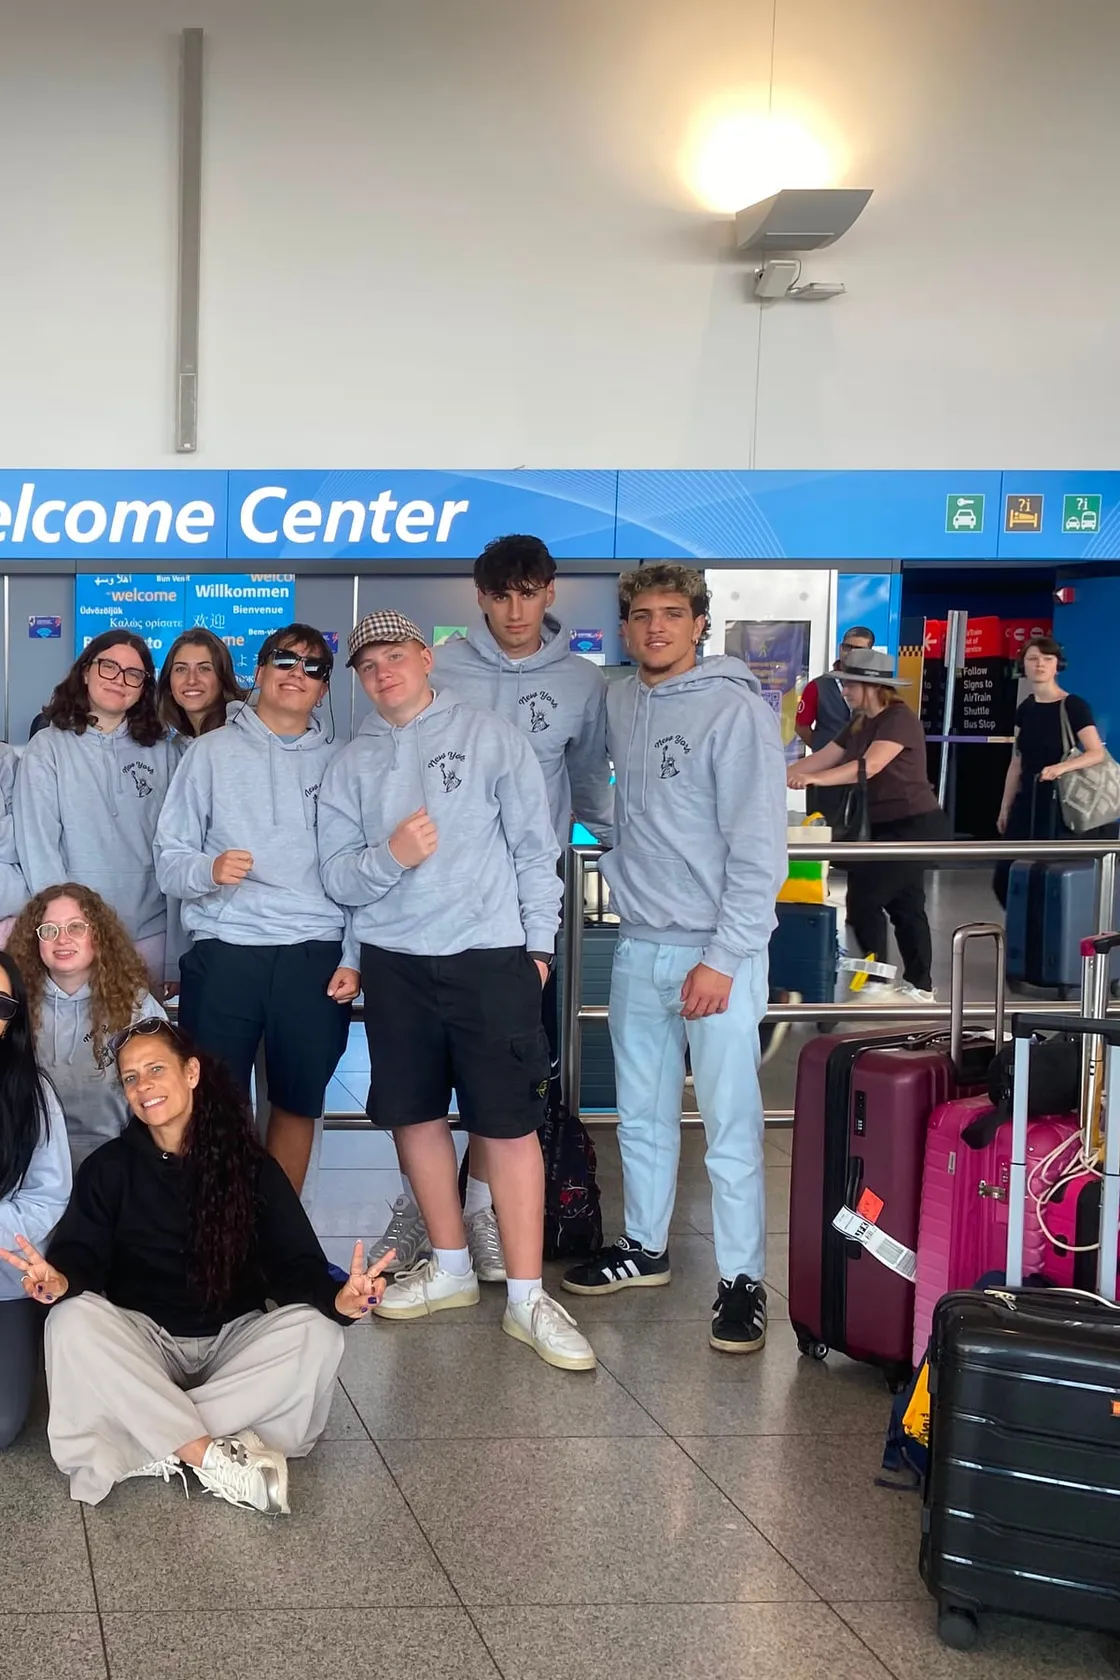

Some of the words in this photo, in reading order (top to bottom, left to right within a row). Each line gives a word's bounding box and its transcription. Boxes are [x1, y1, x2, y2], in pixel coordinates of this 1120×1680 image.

[239, 485, 469, 544] Center
[251, 573, 295, 583] welco
[111, 587, 177, 602] welcome
[195, 584, 289, 598] Willkommen
[233, 605, 283, 614] Bienvenue
[110, 617, 143, 630] Καλώς
[193, 613, 225, 629] 欢迎
[963, 667, 988, 676] Follow
[963, 680, 984, 691] Signs
[985, 680, 993, 688] to
[518, 691, 538, 705] New
[964, 692, 992, 702] AirTrain
[964, 706, 990, 716] Shuttle
[964, 720, 978, 729] Bus
[978, 719, 996, 730] Stop
[654, 735, 673, 749] New
[427, 752, 446, 769] New
